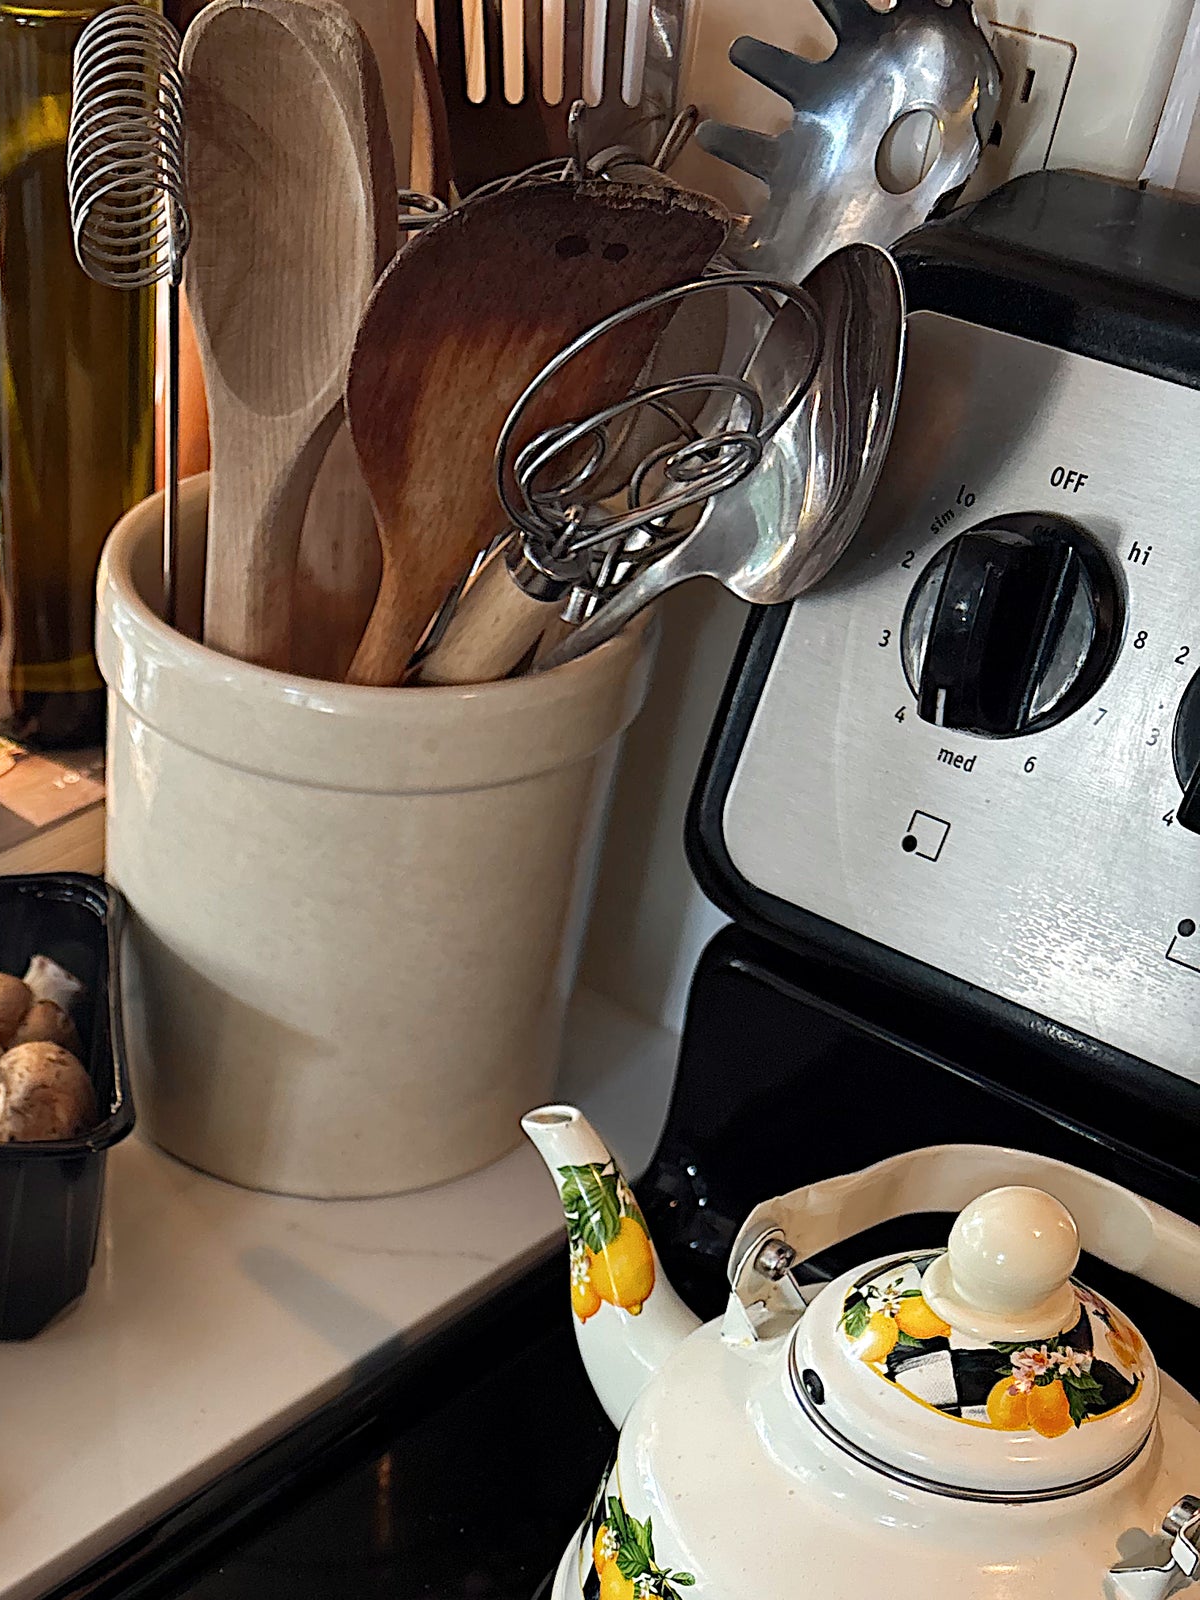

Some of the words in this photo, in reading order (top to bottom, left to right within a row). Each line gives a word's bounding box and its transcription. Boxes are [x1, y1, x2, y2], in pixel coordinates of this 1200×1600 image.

[1050, 466, 1089, 494] OFF
[956, 485, 976, 507] lo
[930, 508, 955, 535] sim
[902, 551, 915, 569] 2
[1127, 541, 1153, 566] hi
[878, 629, 891, 648] 3
[1133, 630, 1149, 650] 8
[1174, 646, 1191, 665] 2
[894, 706, 906, 724] 4
[1093, 707, 1108, 726] 7
[1146, 728, 1160, 747] 3
[936, 747, 978, 774] med
[1023, 755, 1037, 774] 6
[1162, 809, 1174, 827] 4
